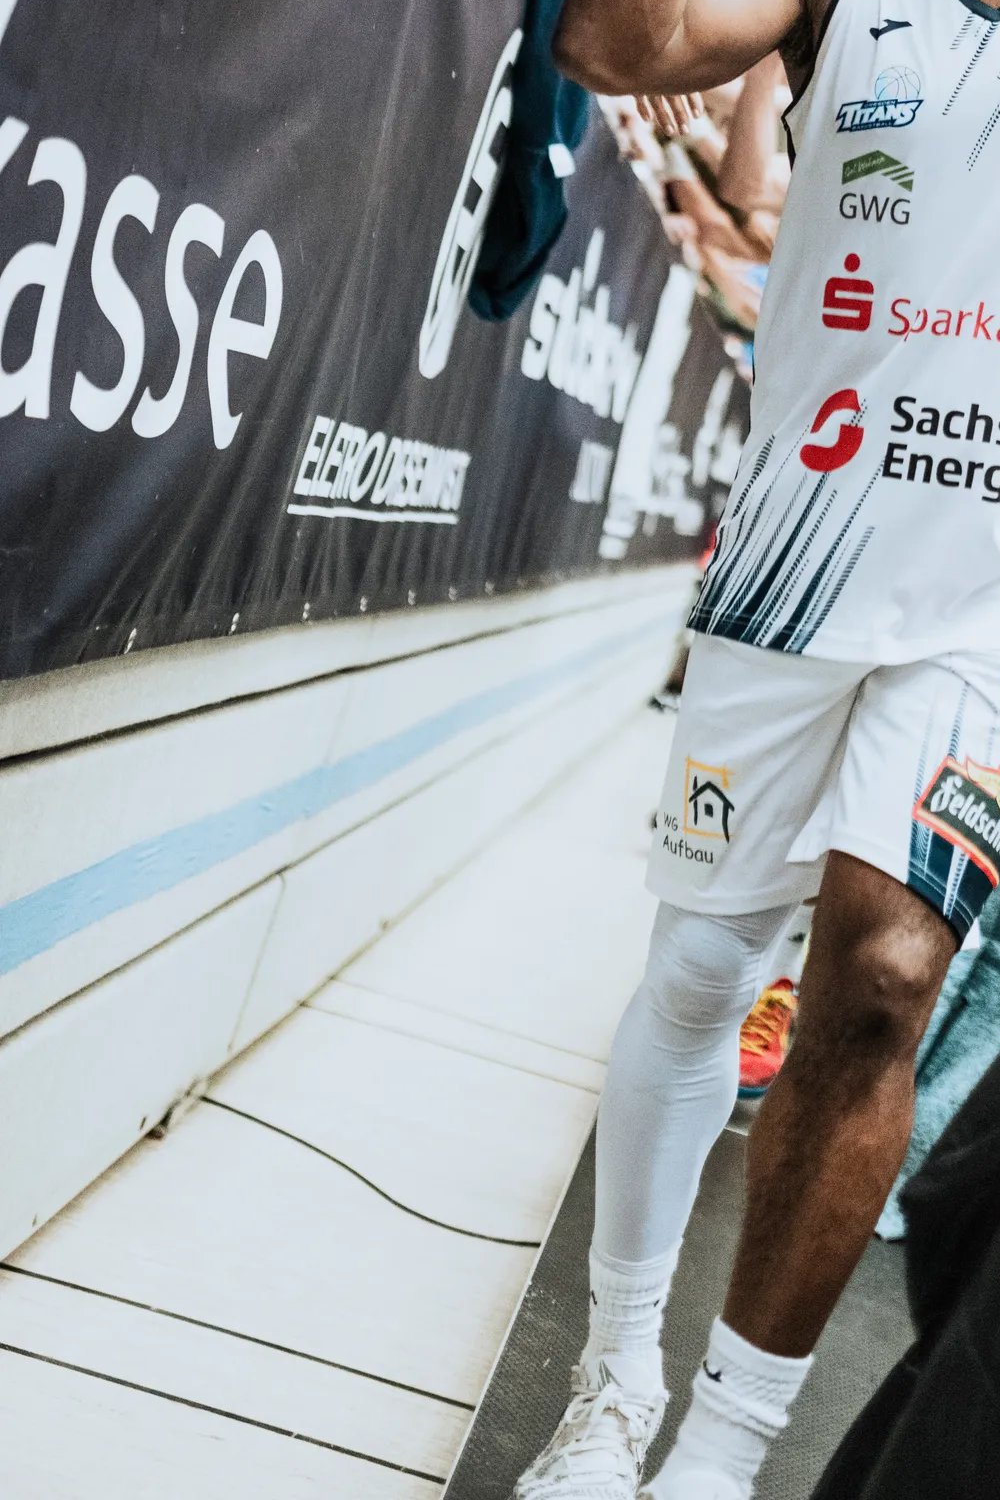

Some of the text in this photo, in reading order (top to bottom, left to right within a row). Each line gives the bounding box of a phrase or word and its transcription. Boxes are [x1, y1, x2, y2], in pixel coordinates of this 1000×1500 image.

[836, 99, 924, 132] TITANS
[839, 192, 911, 225] GWG
[663, 811, 679, 832] WG
[662, 834, 714, 865] Aufbau
